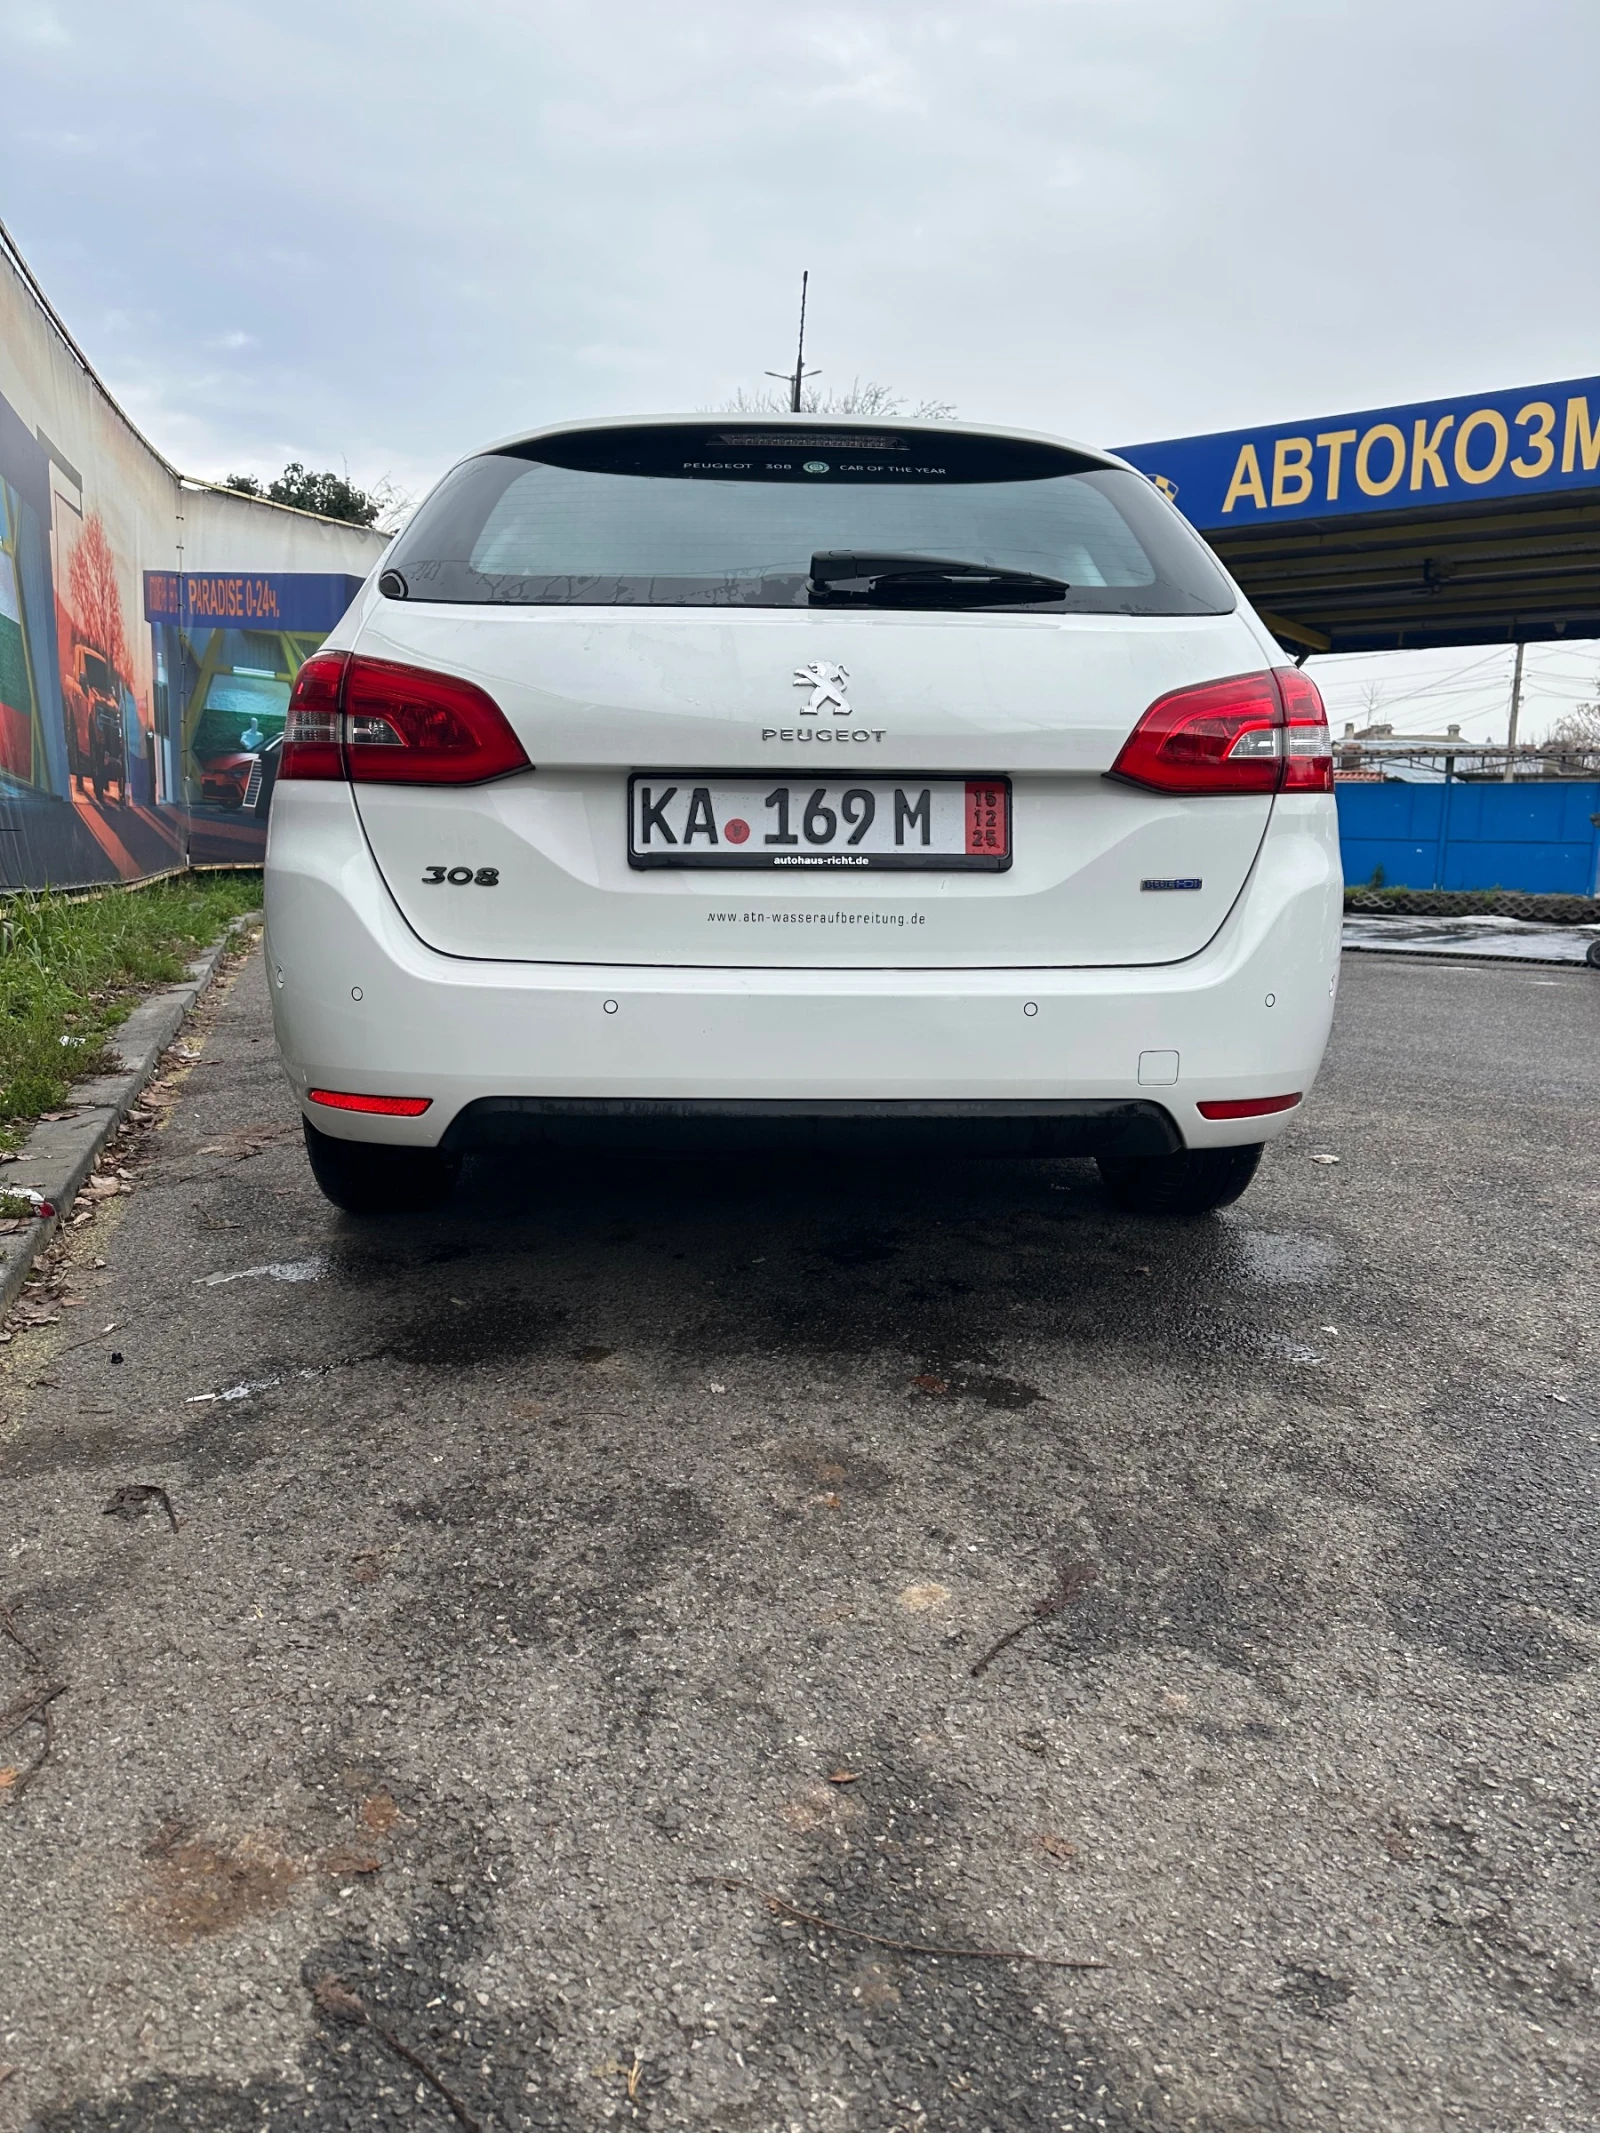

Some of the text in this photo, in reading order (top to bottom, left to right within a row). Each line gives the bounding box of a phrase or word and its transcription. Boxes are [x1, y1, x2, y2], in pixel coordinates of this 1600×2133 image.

[683, 462, 754, 470] PEUGEOT
[839, 464, 864, 472] CAR
[915, 467, 947, 475] YEAR
[187, 579, 244, 617] PARADISE
[761, 727, 888, 743] PEUGEOT
[973, 790, 997, 808] 15
[641, 787, 932, 846] KA 169 M
[973, 809, 997, 828] 12
[971, 829, 998, 848] 25
[773, 856, 870, 865] autohaus-richt.de
[421, 866, 500, 887] 308
[707, 911, 926, 927] www.atn-wasseraufbereitung.de
